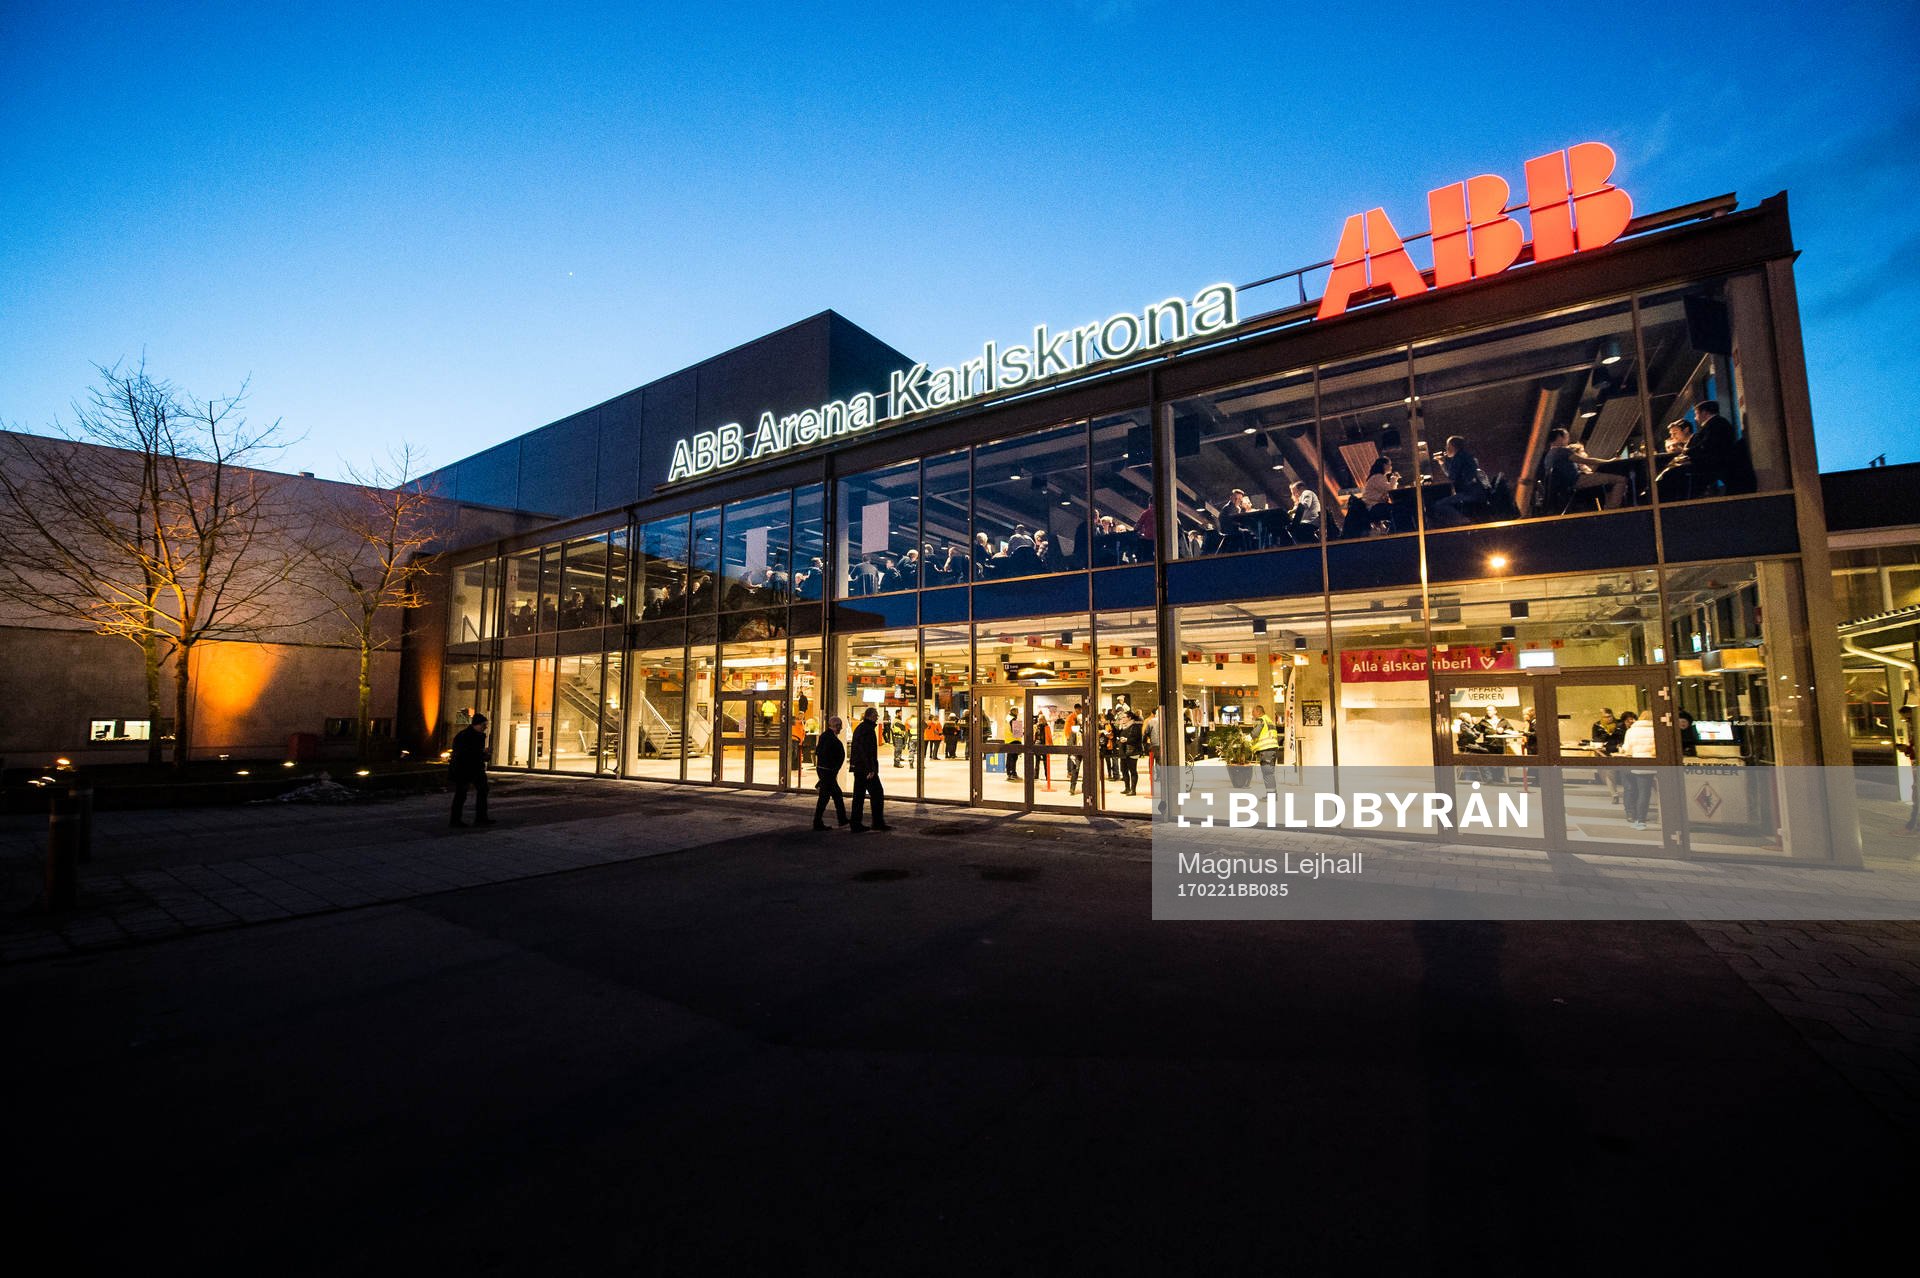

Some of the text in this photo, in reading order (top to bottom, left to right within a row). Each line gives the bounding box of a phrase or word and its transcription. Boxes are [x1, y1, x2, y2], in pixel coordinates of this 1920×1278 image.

[1317, 142, 1634, 320] ABB
[668, 282, 1239, 482] ABB Arena Karlskrona
[1352, 661, 1377, 673] Alla
